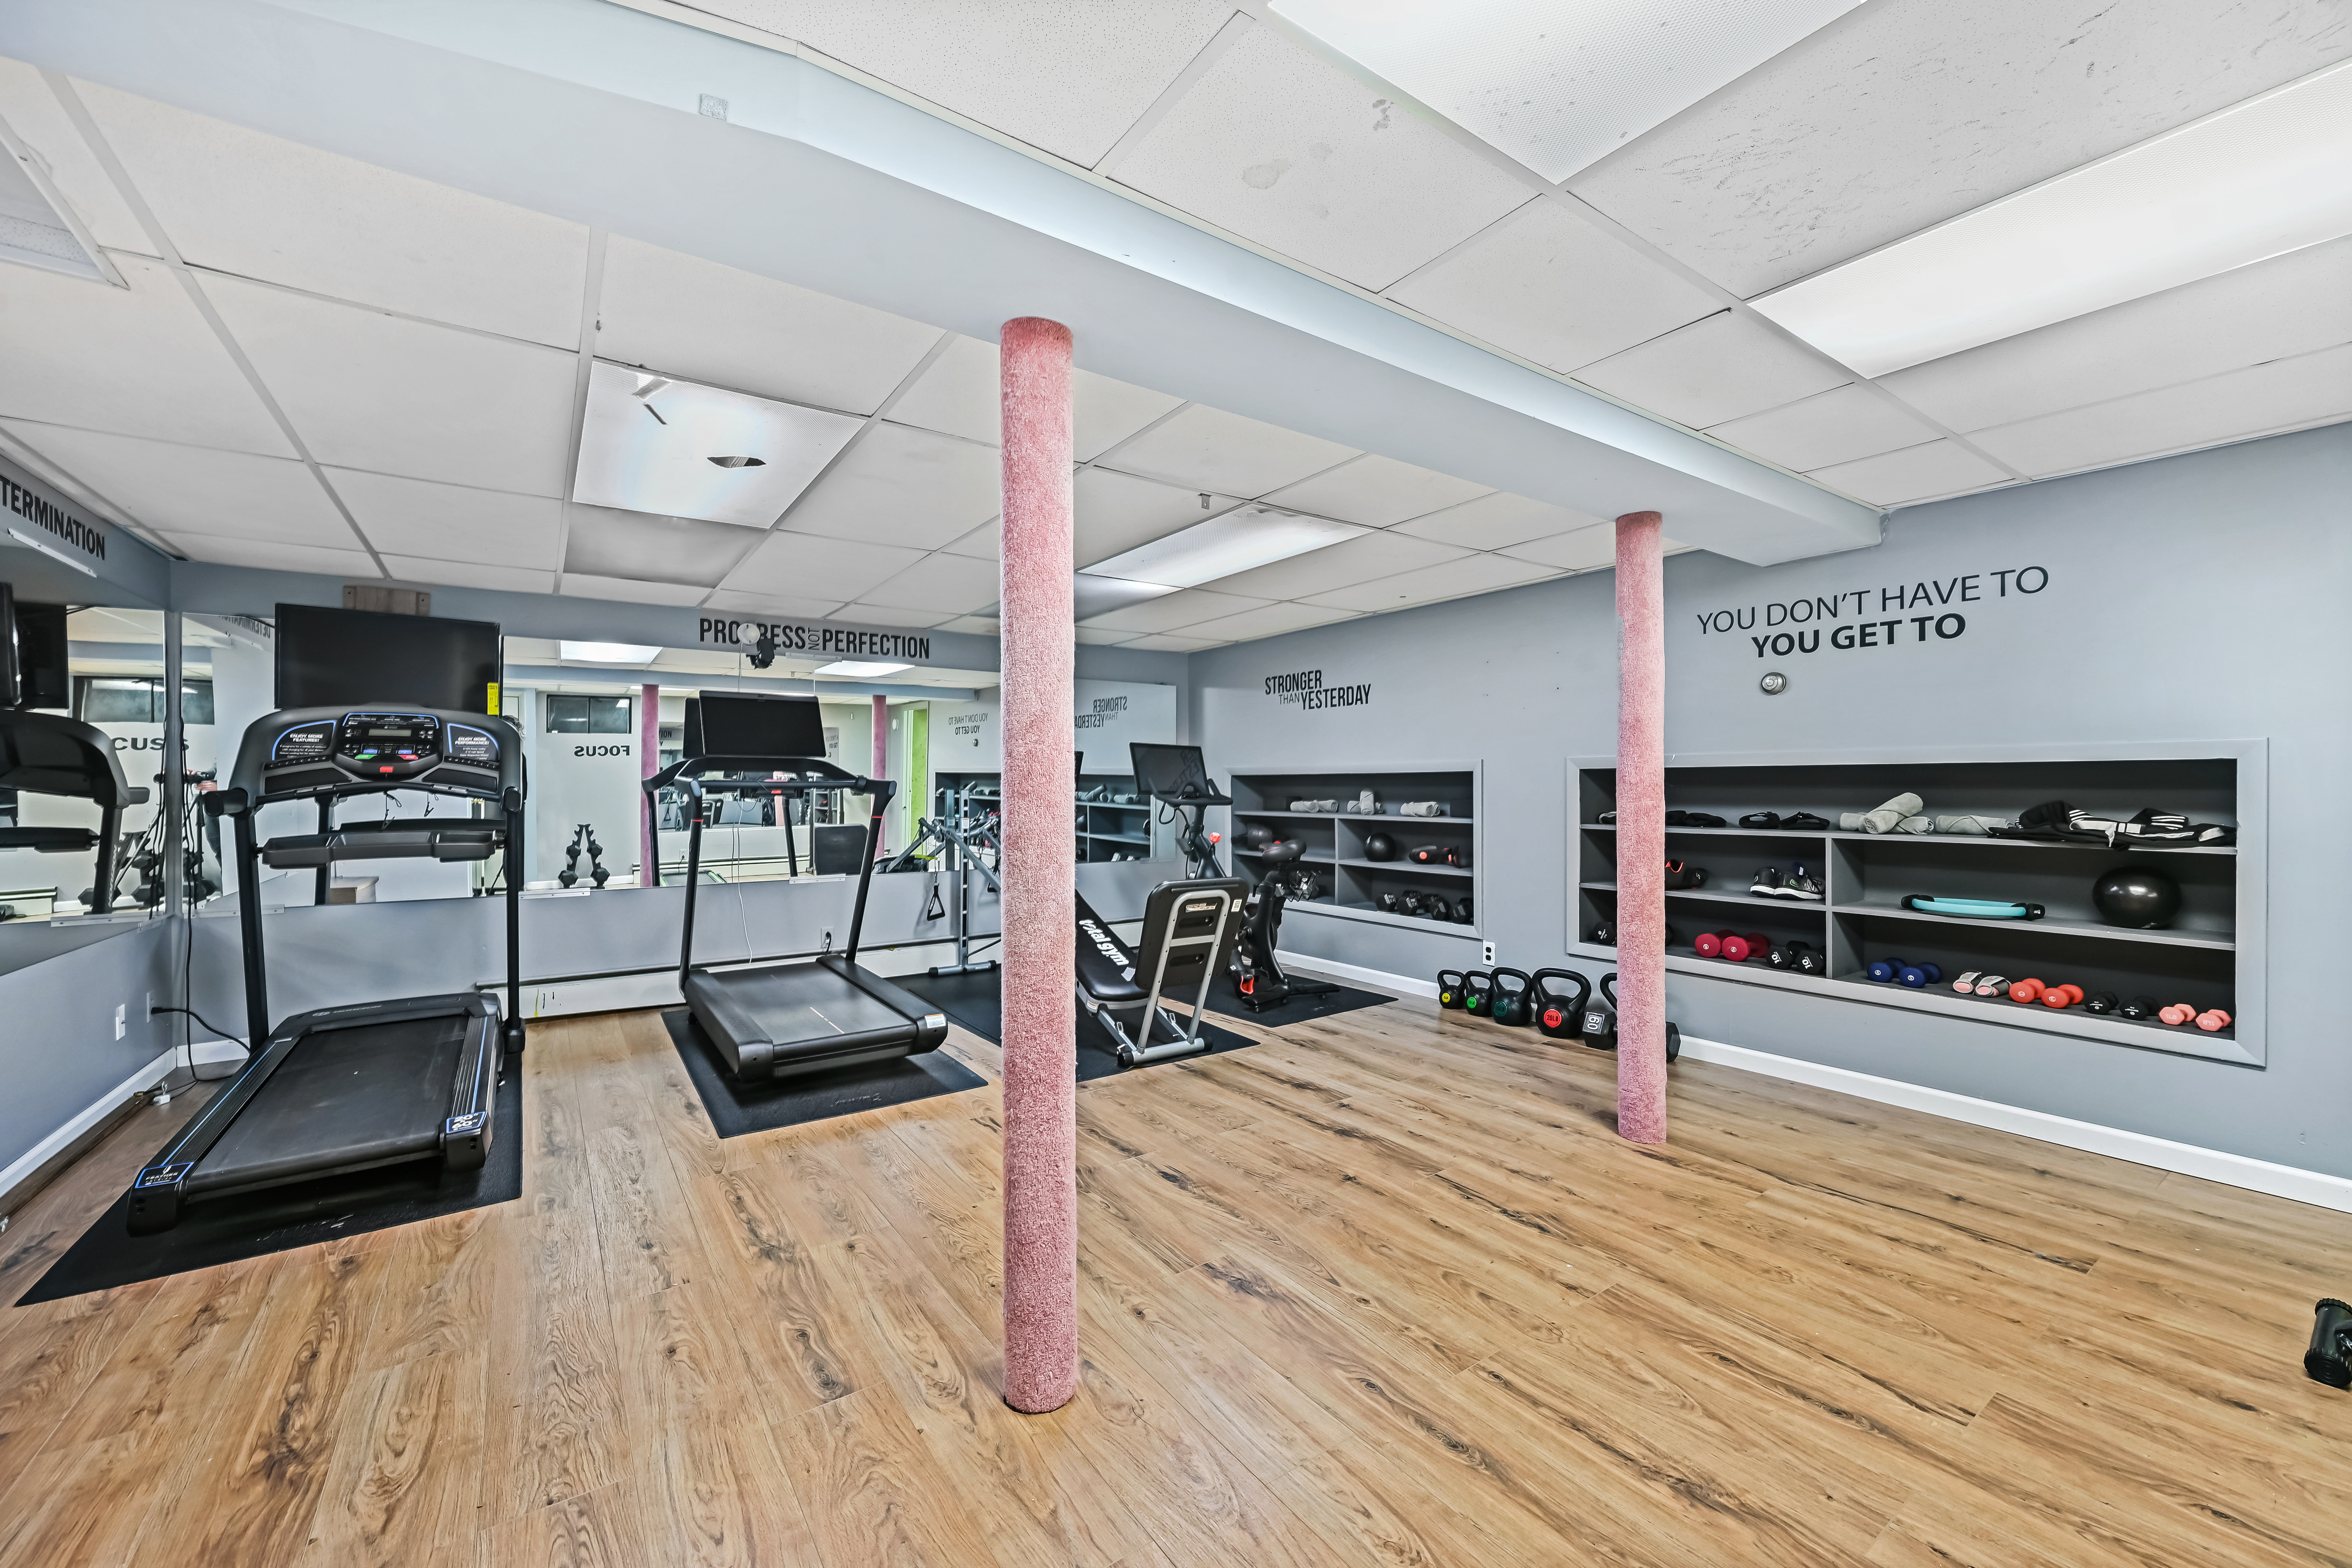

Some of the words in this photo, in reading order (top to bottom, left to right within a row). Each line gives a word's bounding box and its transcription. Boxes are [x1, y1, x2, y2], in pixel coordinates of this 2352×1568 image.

[1696, 607, 1755, 635] YOU
[1767, 590, 1871, 626] DON'T
[1882, 574, 1981, 612] HAVE
[1990, 566, 2049, 597] TO
[700, 618, 806, 649] PRORESS
[808, 627, 820, 651] NOT
[822, 628, 929, 659] PERFECTION
[1751, 630, 1820, 658] YOU
[1831, 620, 1902, 650] GET
[1911, 613, 1966, 642] TO
[1265, 669, 1322, 695] STRONGER
[1279, 692, 1300, 705] THAN
[1301, 684, 1371, 710] YESTERDAY
[1771, 954, 1780, 964] 10
[1802, 959, 1811, 969] 10
[1587, 1016, 1600, 1030] 60
